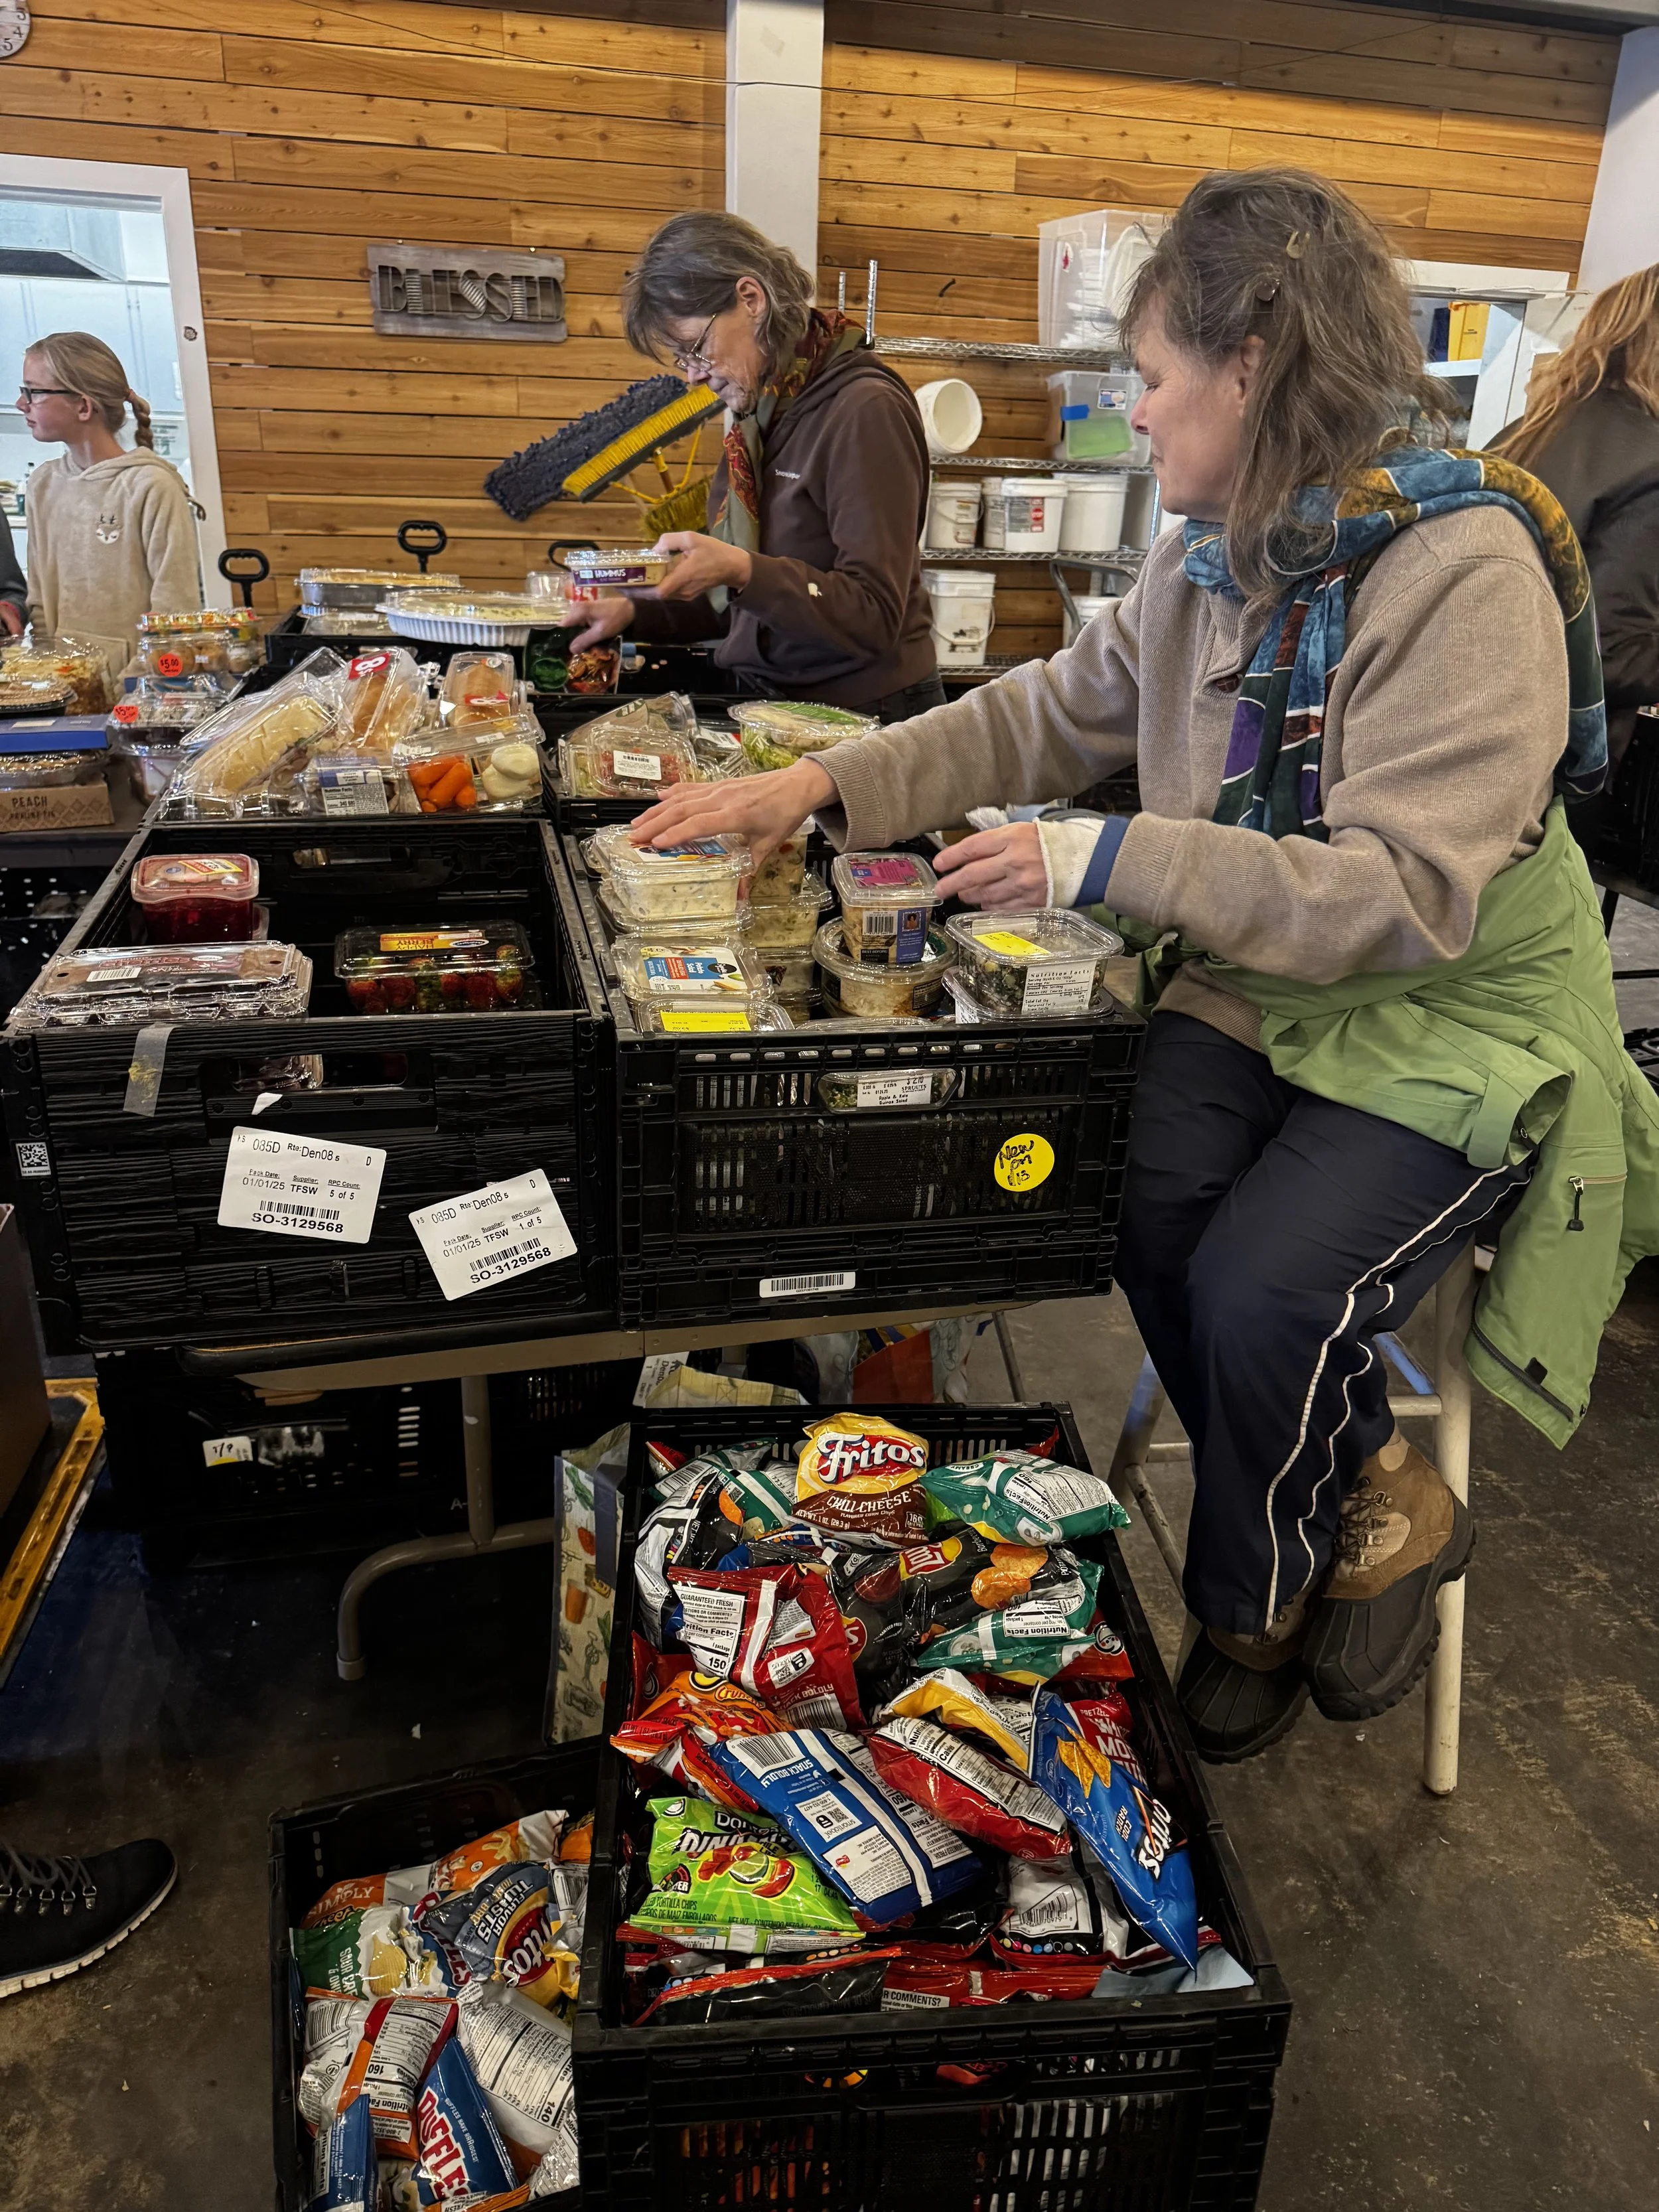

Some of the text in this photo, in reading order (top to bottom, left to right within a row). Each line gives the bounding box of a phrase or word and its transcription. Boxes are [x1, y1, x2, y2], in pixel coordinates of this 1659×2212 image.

[13, 27, 24, 38] 4
[3, 38, 13, 51] 5
[378, 265, 563, 323] BLESSED
[595, 569, 626, 577] HUMMUS
[11, 796, 48, 808] PEACH
[287, 1143, 302, 1152] Rte:
[301, 1146, 334, 1161] Den08
[366, 1156, 372, 1166] D
[265, 1170, 281, 1179] Date:
[292, 1175, 319, 1185] Supplier:
[242, 1177, 285, 1191] 01/01/25
[290, 1184, 319, 1195] TFSW
[342, 1181, 361, 1189] Count:
[529, 1179, 536, 1189] D
[459, 1201, 473, 1211] Rte:
[472, 1191, 503, 1211] Den08
[511, 1206, 542, 1222] RPC Count:
[251, 1212, 344, 1234] SO-3129568
[481, 1220, 506, 1234] Supplier:
[527, 1218, 535, 1228] of
[458, 1232, 472, 1243] Date:
[484, 1228, 510, 1244] TFSW
[443, 1238, 482, 1258] 01/01/25
[470, 1246, 552, 1284] SO-3129568
[816, 1431, 926, 1485] Fritos
[1018, 1472, 1033, 1484] 160
[826, 1490, 912, 1514] CHILI CHEESE
[1006, 1489, 1025, 1504] Facts
[807, 1512, 818, 1522] WT.
[680, 1593, 715, 1605] GUARANTEED
[710, 1628, 734, 1639] Facts
[1030, 1626, 1068, 1635] Nutrition
[709, 1657, 727, 1670] 150
[802, 1683, 834, 1698] BOLDLY
[786, 1758, 814, 1776] SNACK
[760, 1771, 787, 1789] BOLDLY
[911, 1818, 929, 1829] Facts
[1116, 1805, 1128, 1834] RANCH
[1121, 1819, 1132, 1842] COOL
[307, 1885, 375, 1917] SIMPLY
[656, 1898, 697, 1911] TORTILLA CHIPS
[476, 1880, 534, 1943] TWISTS
[493, 1893, 526, 1937] FLAVOR
[659, 1910, 666, 1919] DE
[339, 1947, 352, 1973] SOUR
[891, 1991, 941, 2007] COMMENTS?
[368, 2064, 416, 2088] Calories 160
[540, 2101, 556, 2124] 140
[458, 2118, 470, 2134] HAVE
[319, 2162, 328, 2189] Facts
